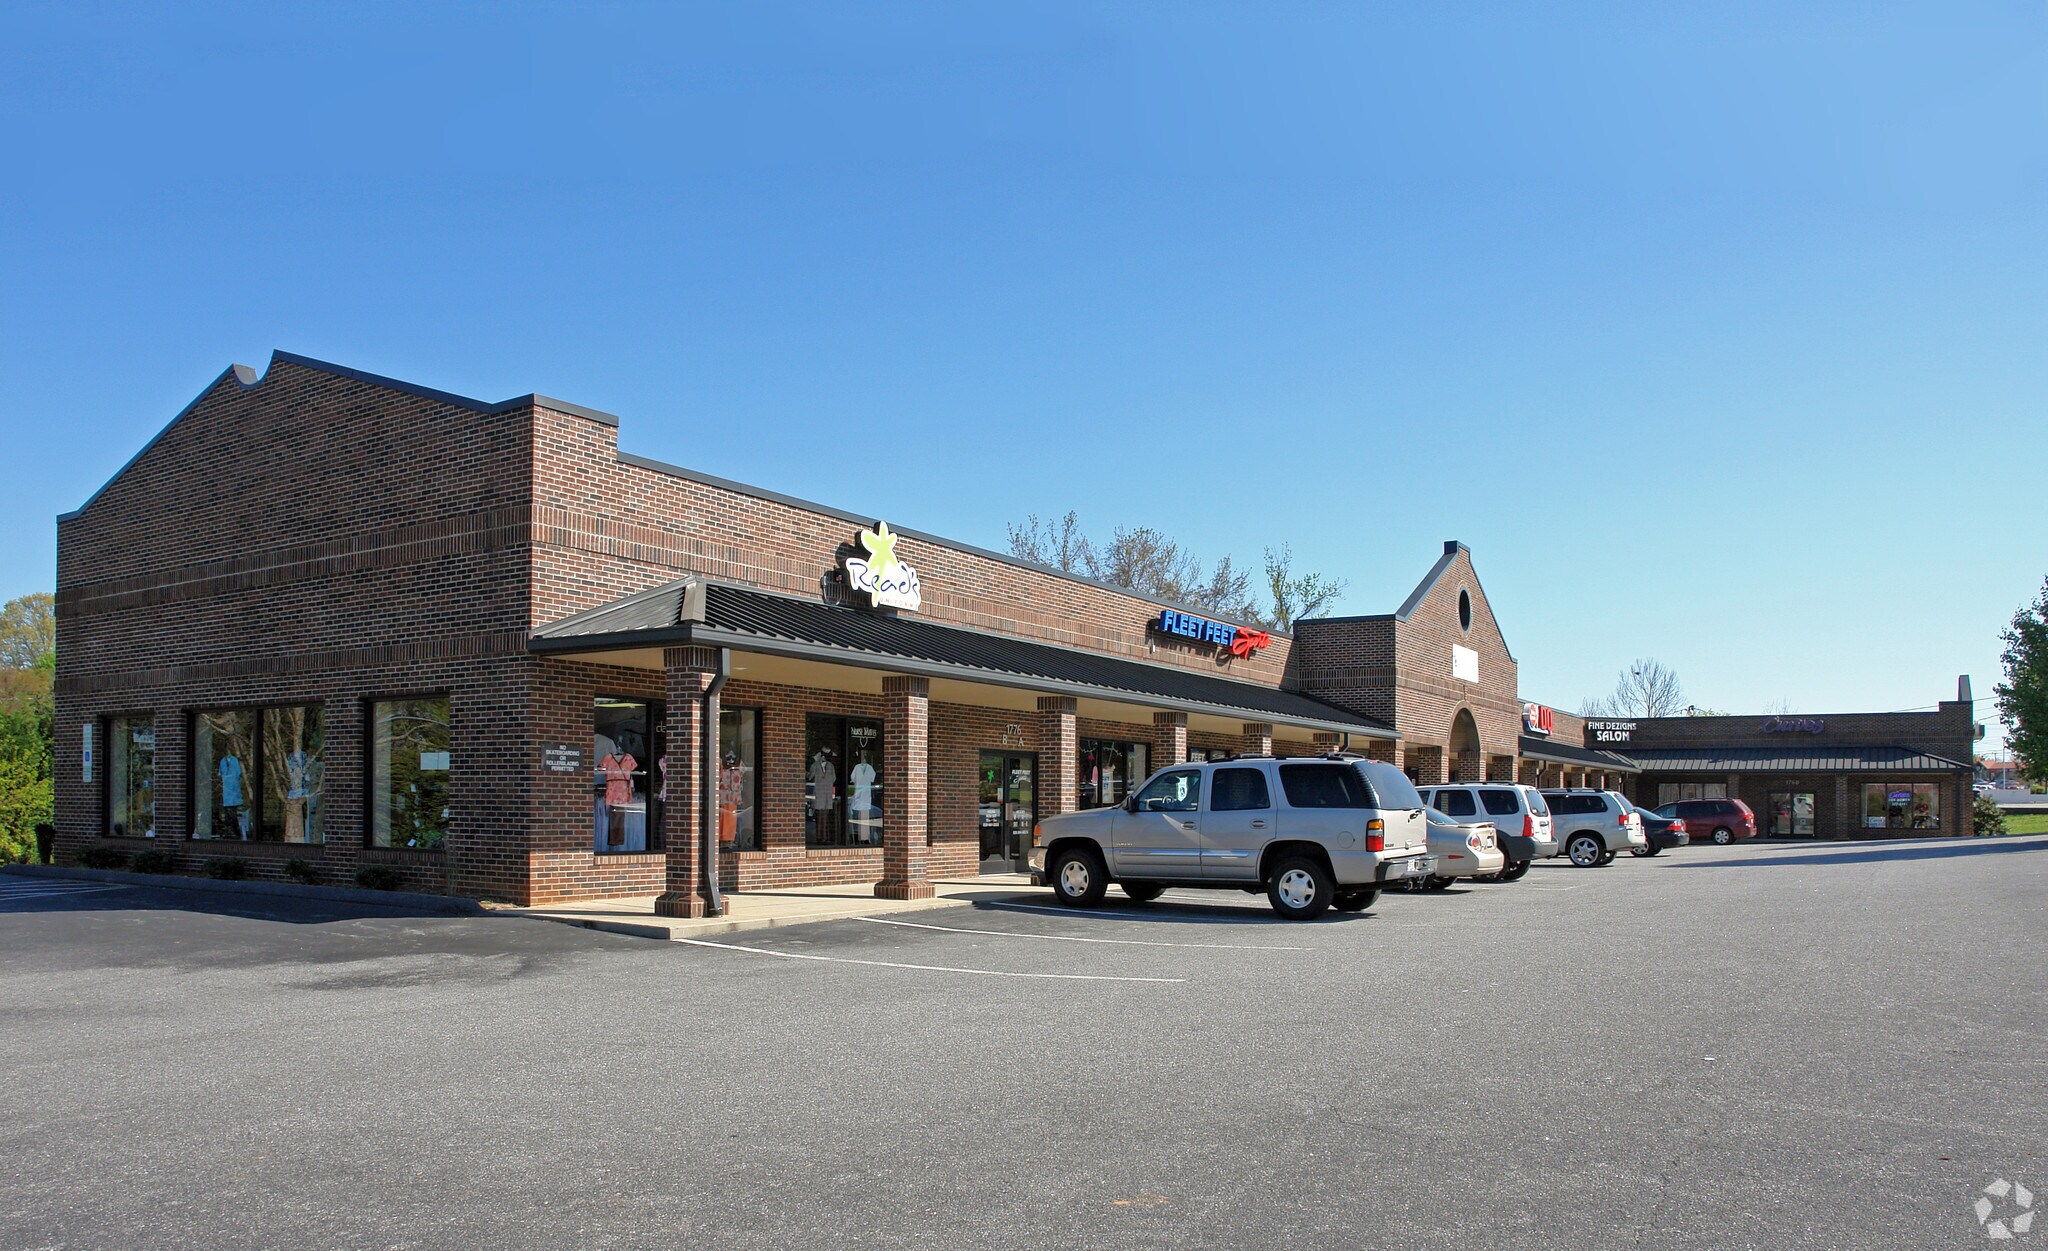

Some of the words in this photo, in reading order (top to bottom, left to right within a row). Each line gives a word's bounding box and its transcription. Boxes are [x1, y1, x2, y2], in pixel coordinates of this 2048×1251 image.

[849, 562, 919, 599] Read's
[1163, 610, 1204, 639] FLEET
[1205, 621, 1237, 646] FEET
[1006, 724, 1022, 736] 1776
[1588, 722, 1605, 731] FINE
[1762, 715, 1824, 734] Curves
[1002, 735, 1008, 745] B
[1018, 737, 1024, 747] A
[1597, 731, 1630, 742] SALON
